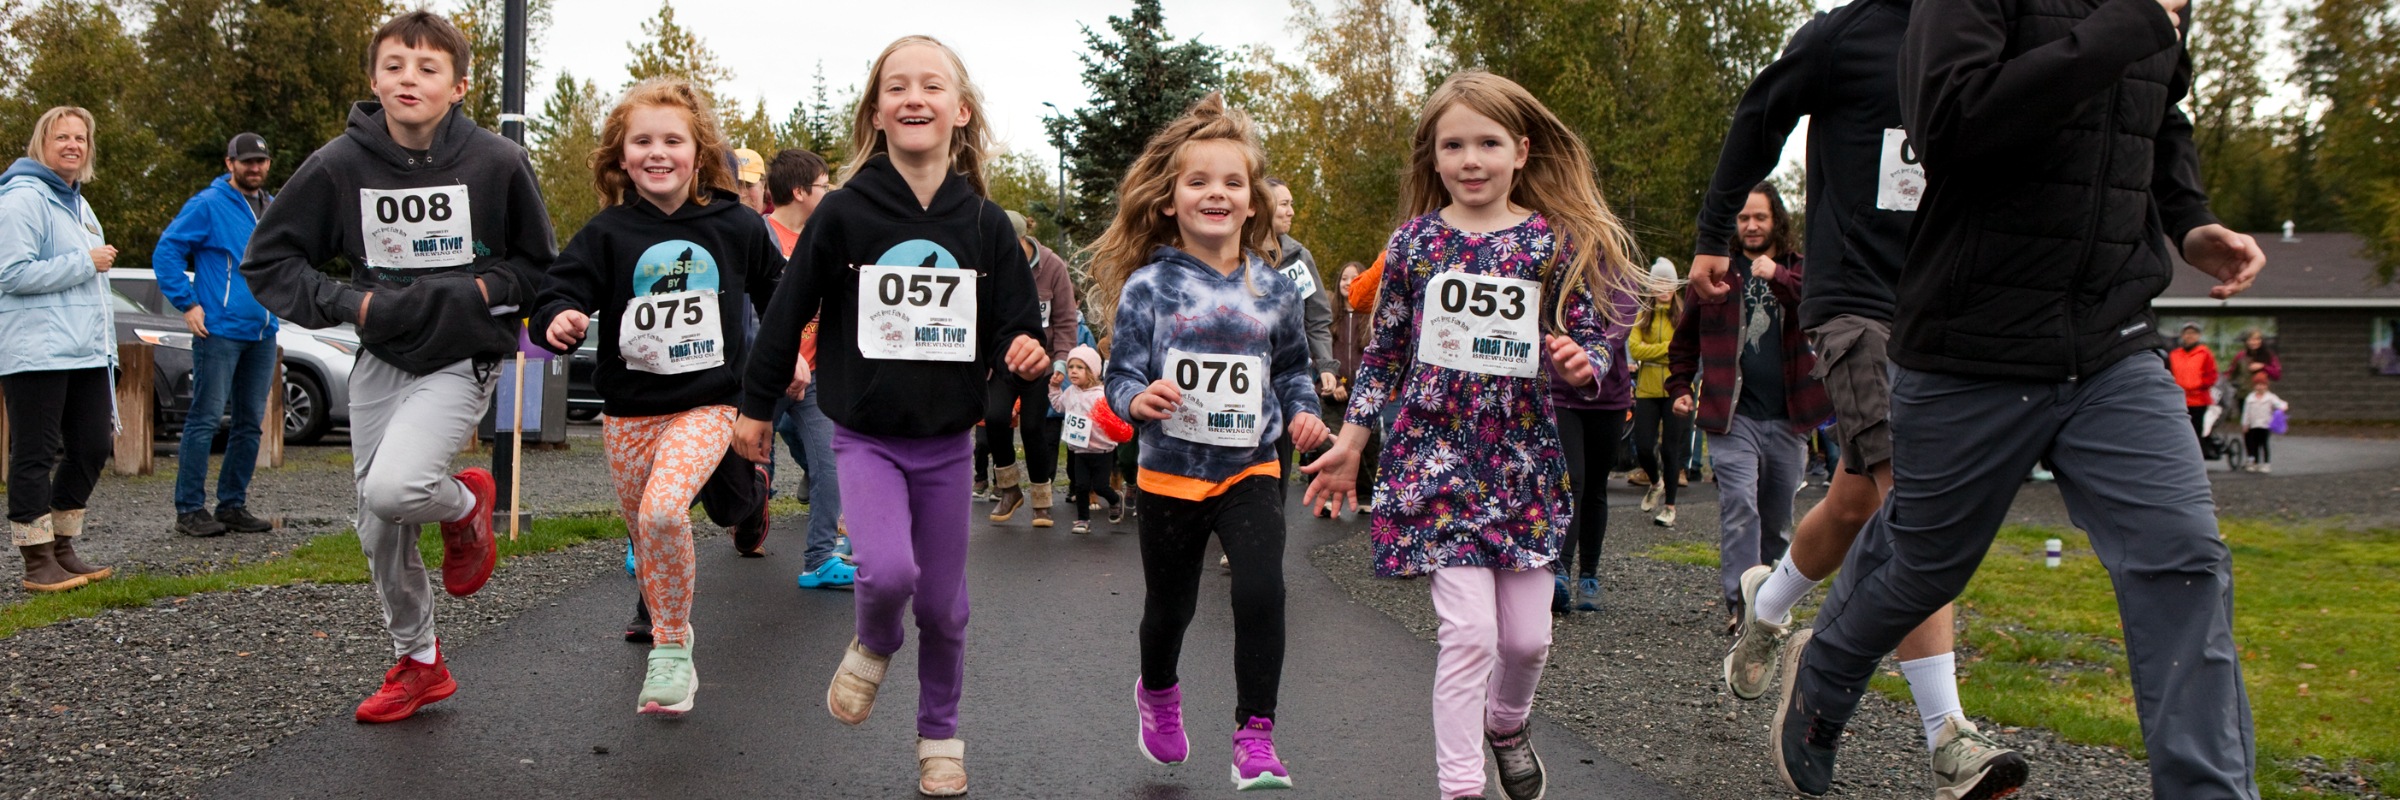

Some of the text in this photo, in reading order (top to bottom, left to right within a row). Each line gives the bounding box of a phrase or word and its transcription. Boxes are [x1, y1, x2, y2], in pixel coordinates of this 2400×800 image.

[376, 192, 452, 224] 008
[413, 236, 463, 253] kenai river
[643, 260, 708, 277] RAISED
[668, 278, 680, 288] BY
[878, 273, 960, 307] 057
[1440, 279, 1526, 320] 053
[634, 296, 703, 331] 075
[915, 326, 967, 342] kenai river
[668, 339, 715, 359] kenai river
[1472, 337, 1531, 358] kenai river
[671, 355, 704, 363] BREWING
[1472, 354, 1513, 363] BREWING
[1176, 359, 1249, 394] 076
[1208, 412, 1256, 429] kenai river
